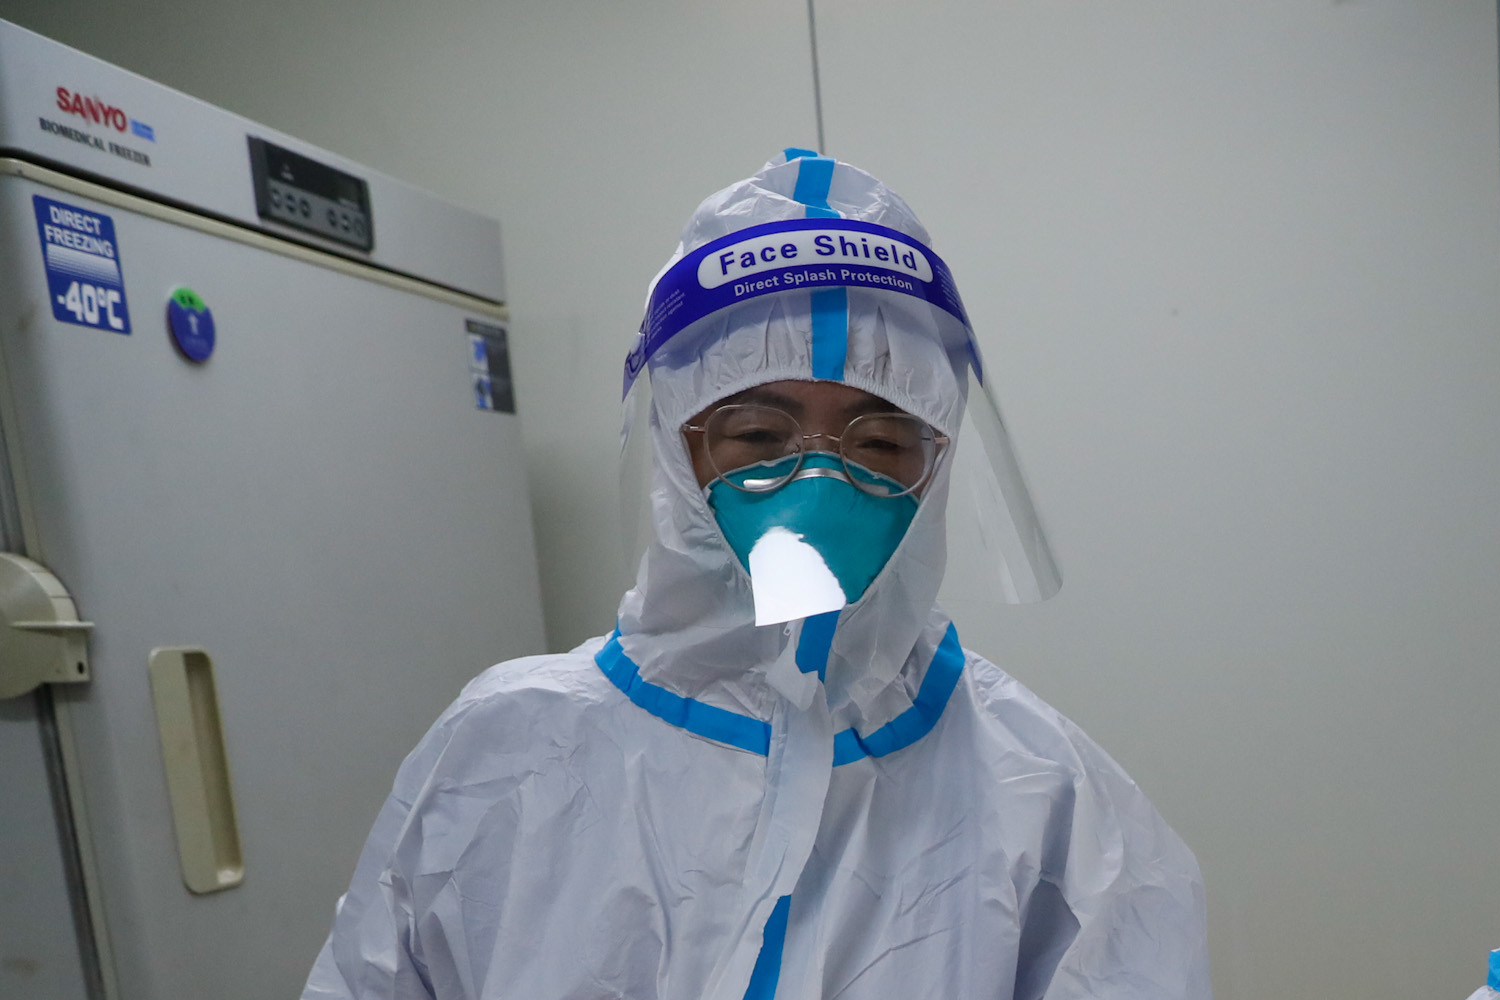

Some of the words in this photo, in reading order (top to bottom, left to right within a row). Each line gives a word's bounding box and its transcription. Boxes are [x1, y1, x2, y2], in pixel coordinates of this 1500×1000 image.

[56, 86, 128, 133] SANYO
[39, 117, 107, 153] BIOMEDICAL
[108, 140, 151, 167] FREEZER
[50, 205, 102, 237] DIRECT
[45, 225, 114, 258] FREEZING
[719, 242, 798, 276] Face
[814, 235, 918, 272] Shield
[734, 274, 780, 297] Direct
[784, 268, 837, 286] Splash
[840, 269, 913, 291] Protection
